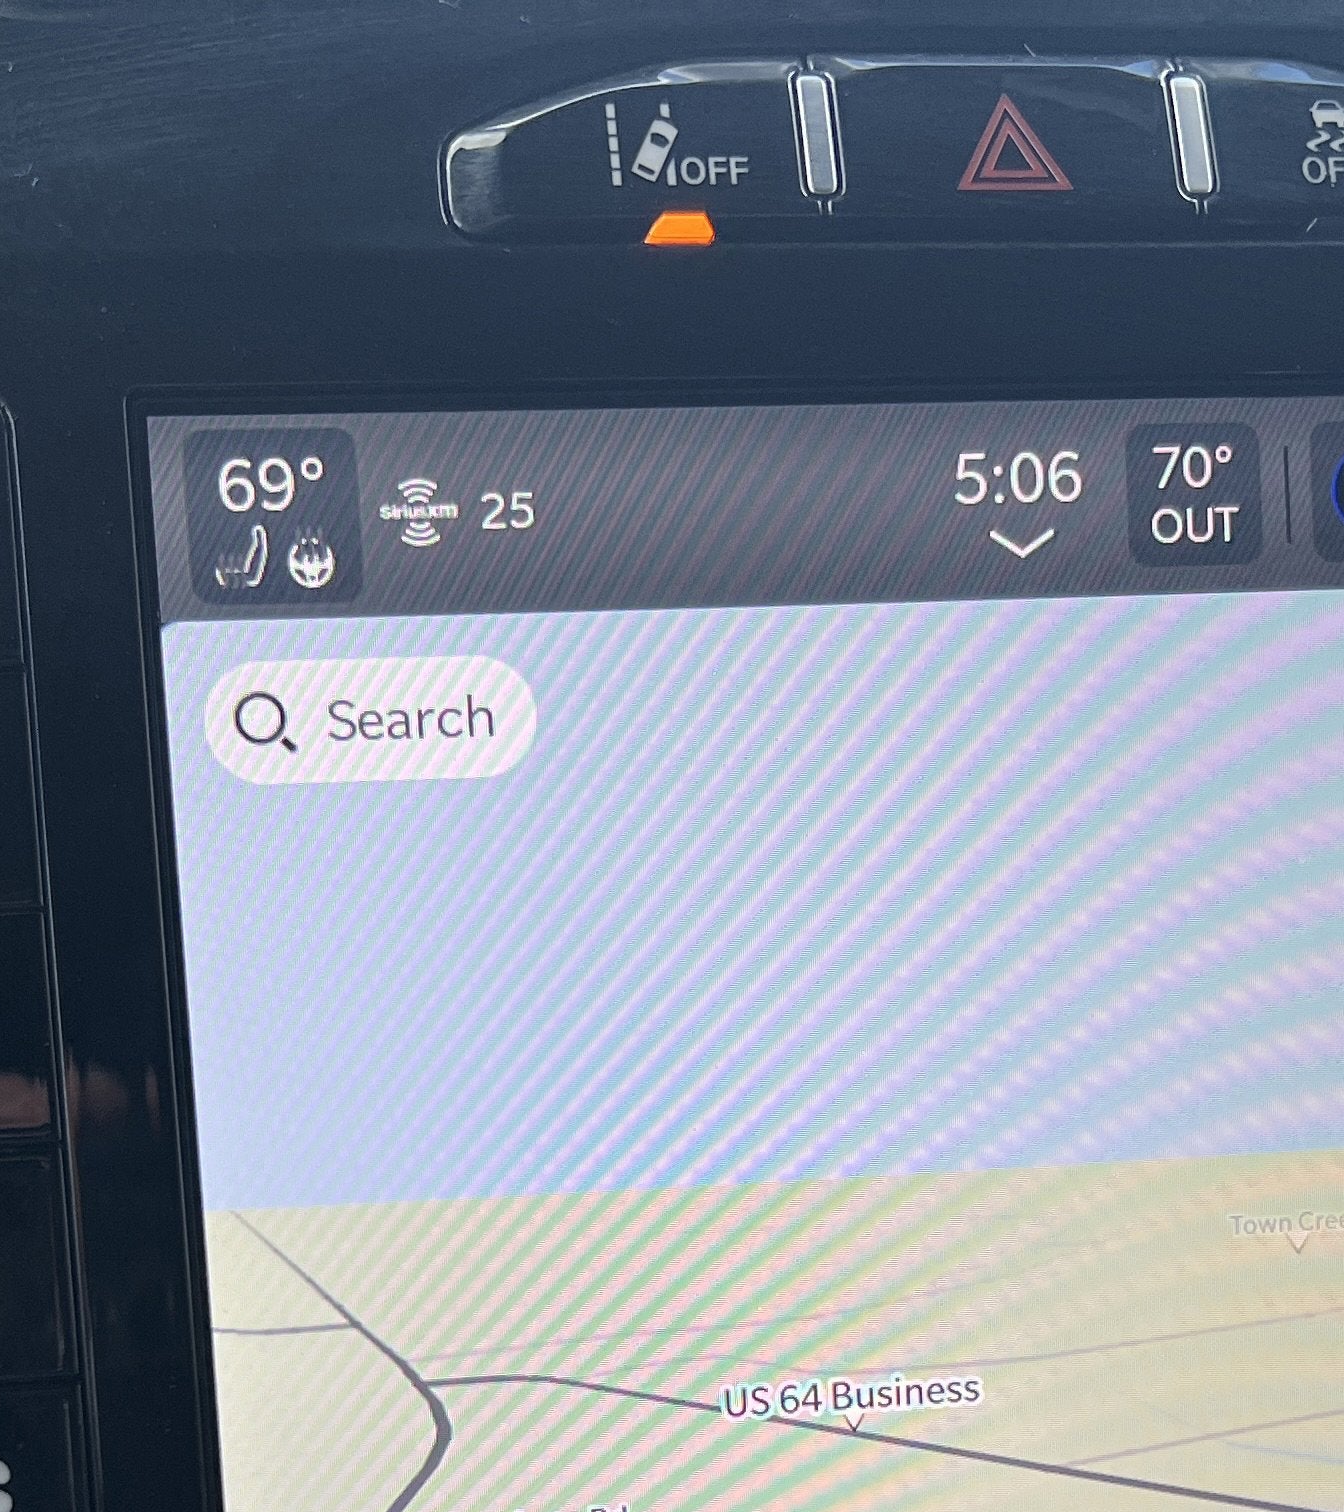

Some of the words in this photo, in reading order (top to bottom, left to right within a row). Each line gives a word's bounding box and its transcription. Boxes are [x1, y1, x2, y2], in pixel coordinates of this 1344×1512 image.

[681, 156, 750, 186] OFF
[217, 456, 325, 513] 69°
[954, 451, 1082, 506] 5:06
[1152, 445, 1233, 490] 70°
[480, 491, 536, 530] 25
[1150, 506, 1239, 544] OUT
[327, 695, 496, 741] Search
[1230, 1213, 1292, 1235] Town
[722, 1386, 771, 1419] US
[780, 1383, 823, 1413] 64
[831, 1375, 981, 1411] Business
